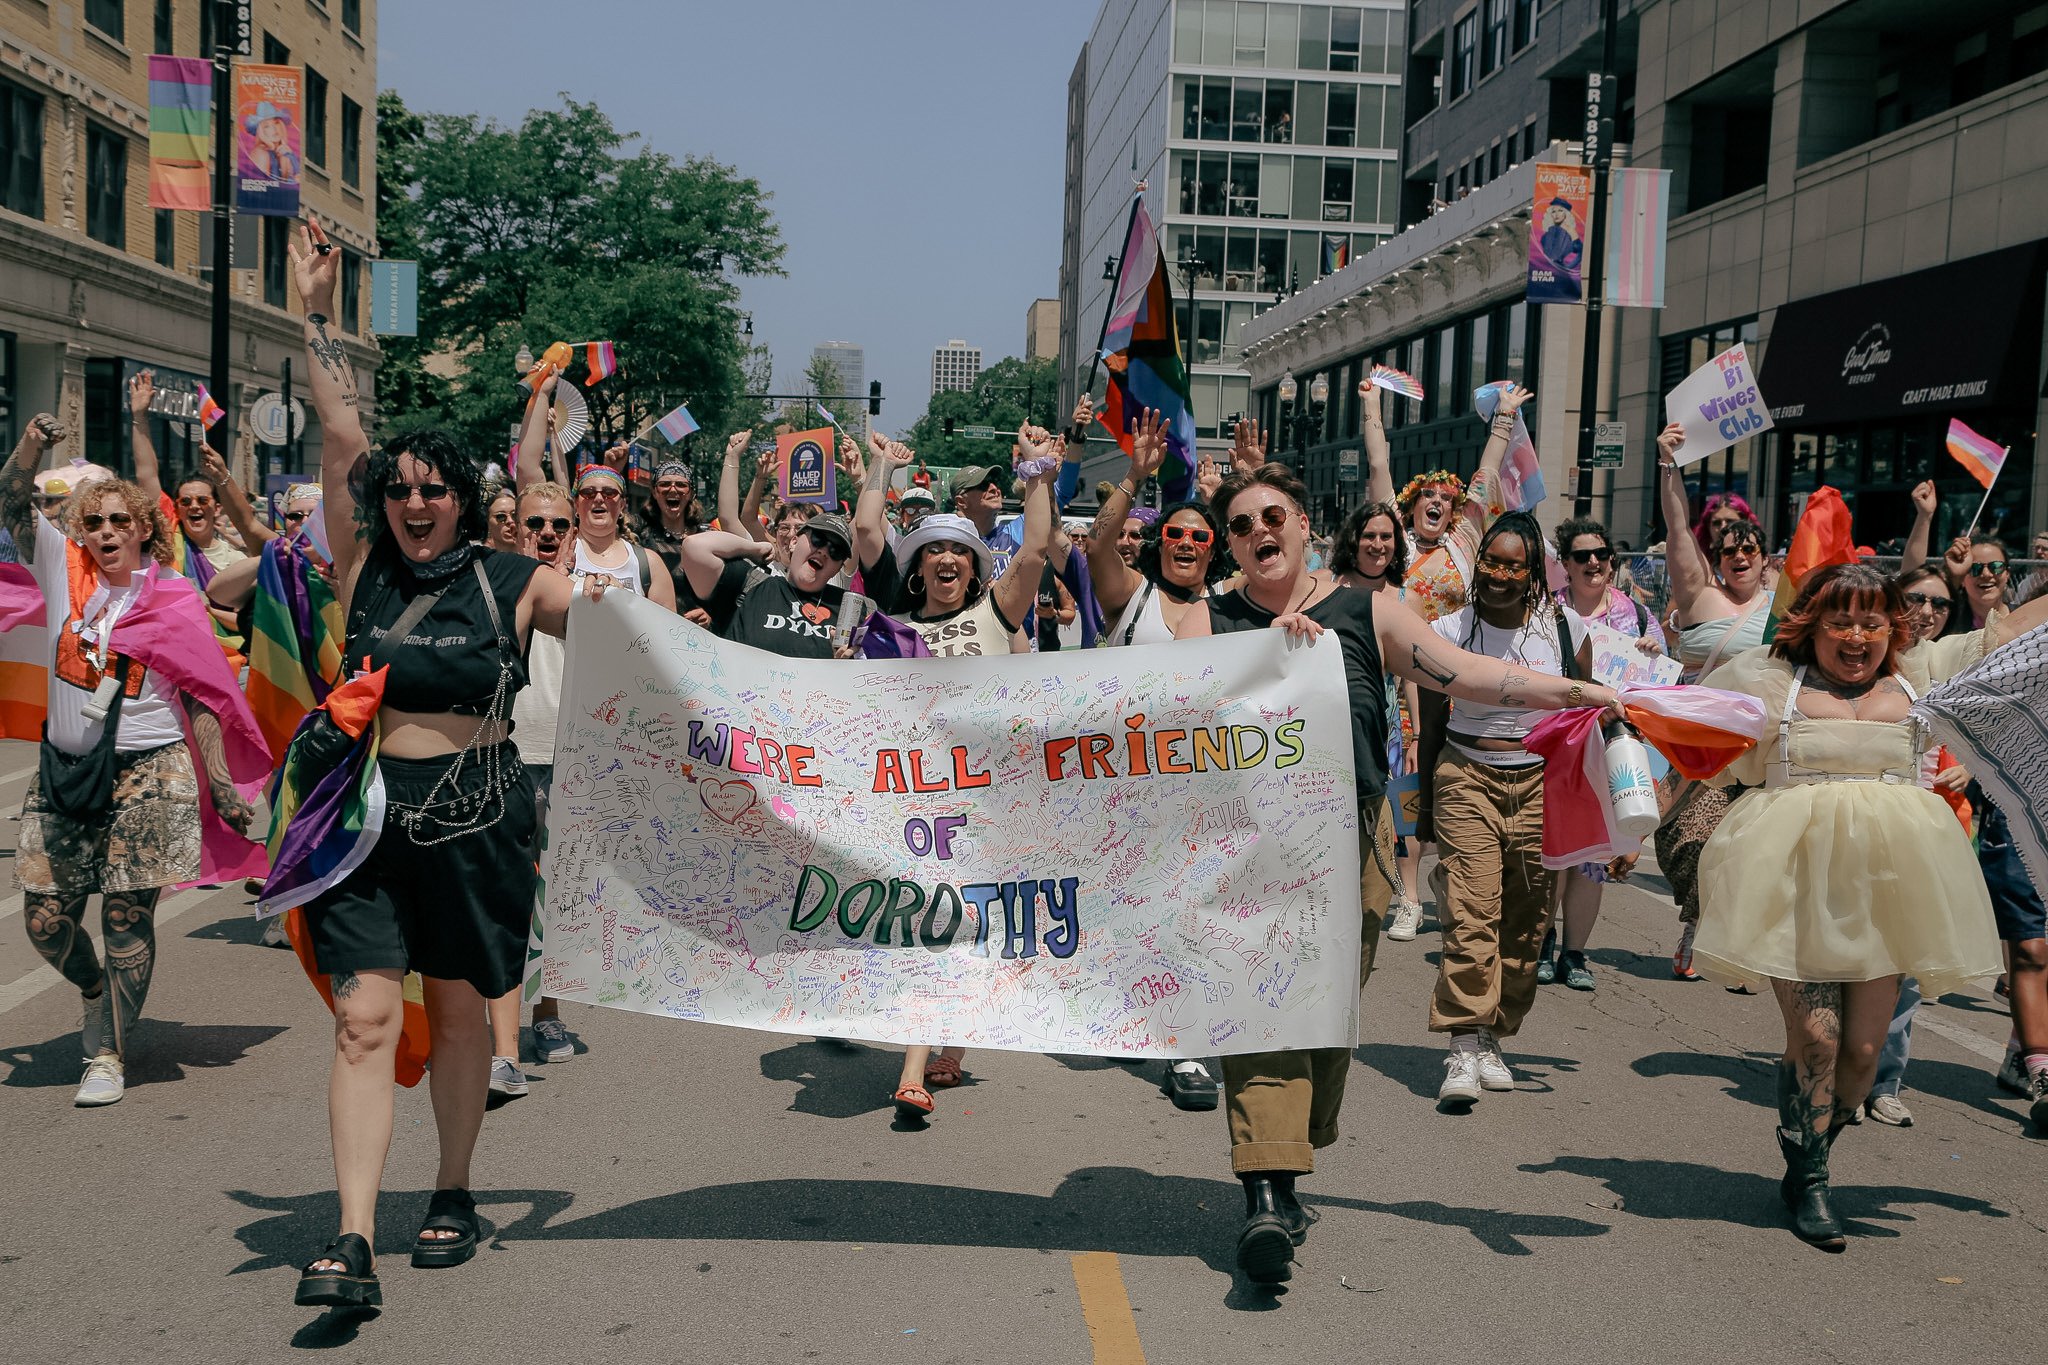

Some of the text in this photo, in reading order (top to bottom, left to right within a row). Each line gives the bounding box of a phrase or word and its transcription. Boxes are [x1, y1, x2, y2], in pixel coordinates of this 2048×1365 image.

[1586, 73, 1602, 164] BR3827
[1539, 173, 1587, 185] MARKET
[390, 263, 399, 330] REMARKABLE
[1712, 350, 1745, 372] The
[1723, 366, 1743, 390] Bi
[1698, 385, 1757, 422] Wives
[1902, 380, 1988, 405] CRAFT MADE DRINKS
[1718, 406, 1764, 441] Club
[792, 470, 820, 480] ALLIED
[792, 478, 819, 487] SPACE
[792, 602, 802, 618] I
[872, 744, 991, 793] ALL
[1160, 783, 1189, 799] Audrey
[1611, 789, 1654, 805] SAMIGOS
[903, 814, 968, 860] OF
[642, 909, 665, 919] NEVER
[787, 864, 1080, 959] DOROTHY
